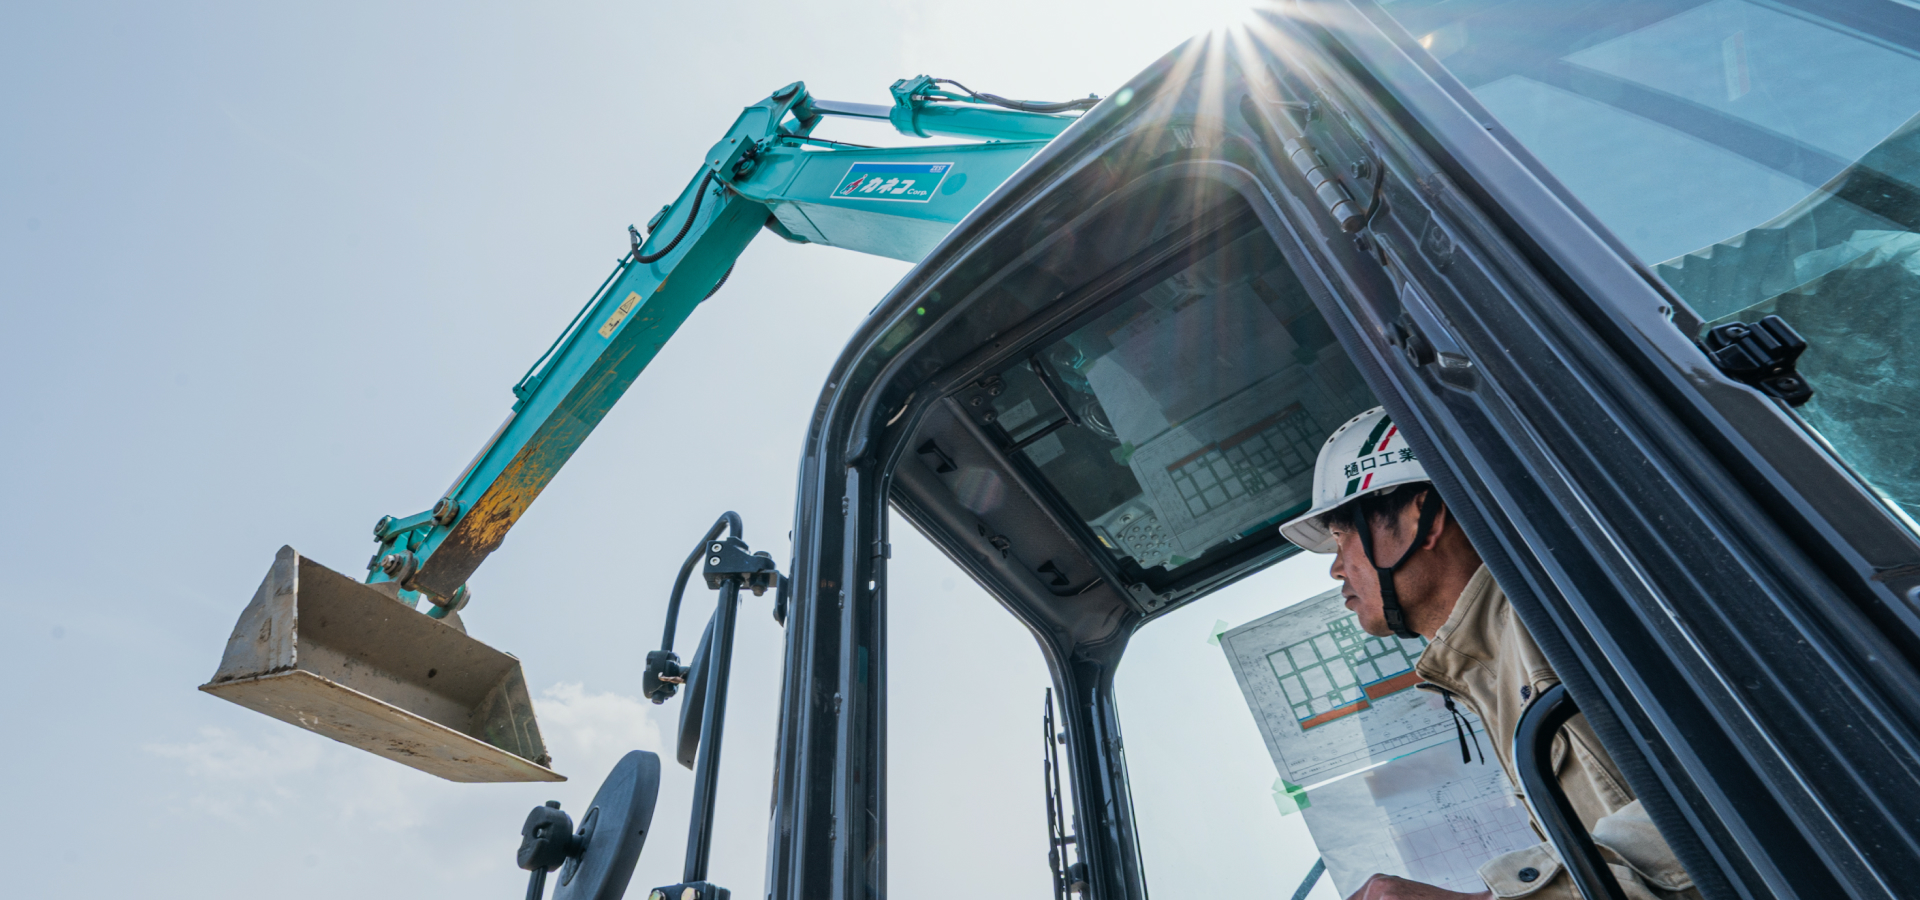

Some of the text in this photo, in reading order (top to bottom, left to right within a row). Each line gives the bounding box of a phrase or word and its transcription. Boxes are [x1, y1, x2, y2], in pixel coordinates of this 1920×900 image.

[859, 177, 927, 196] カネコ Corp.
[1344, 448, 1417, 478] 樋口工業
